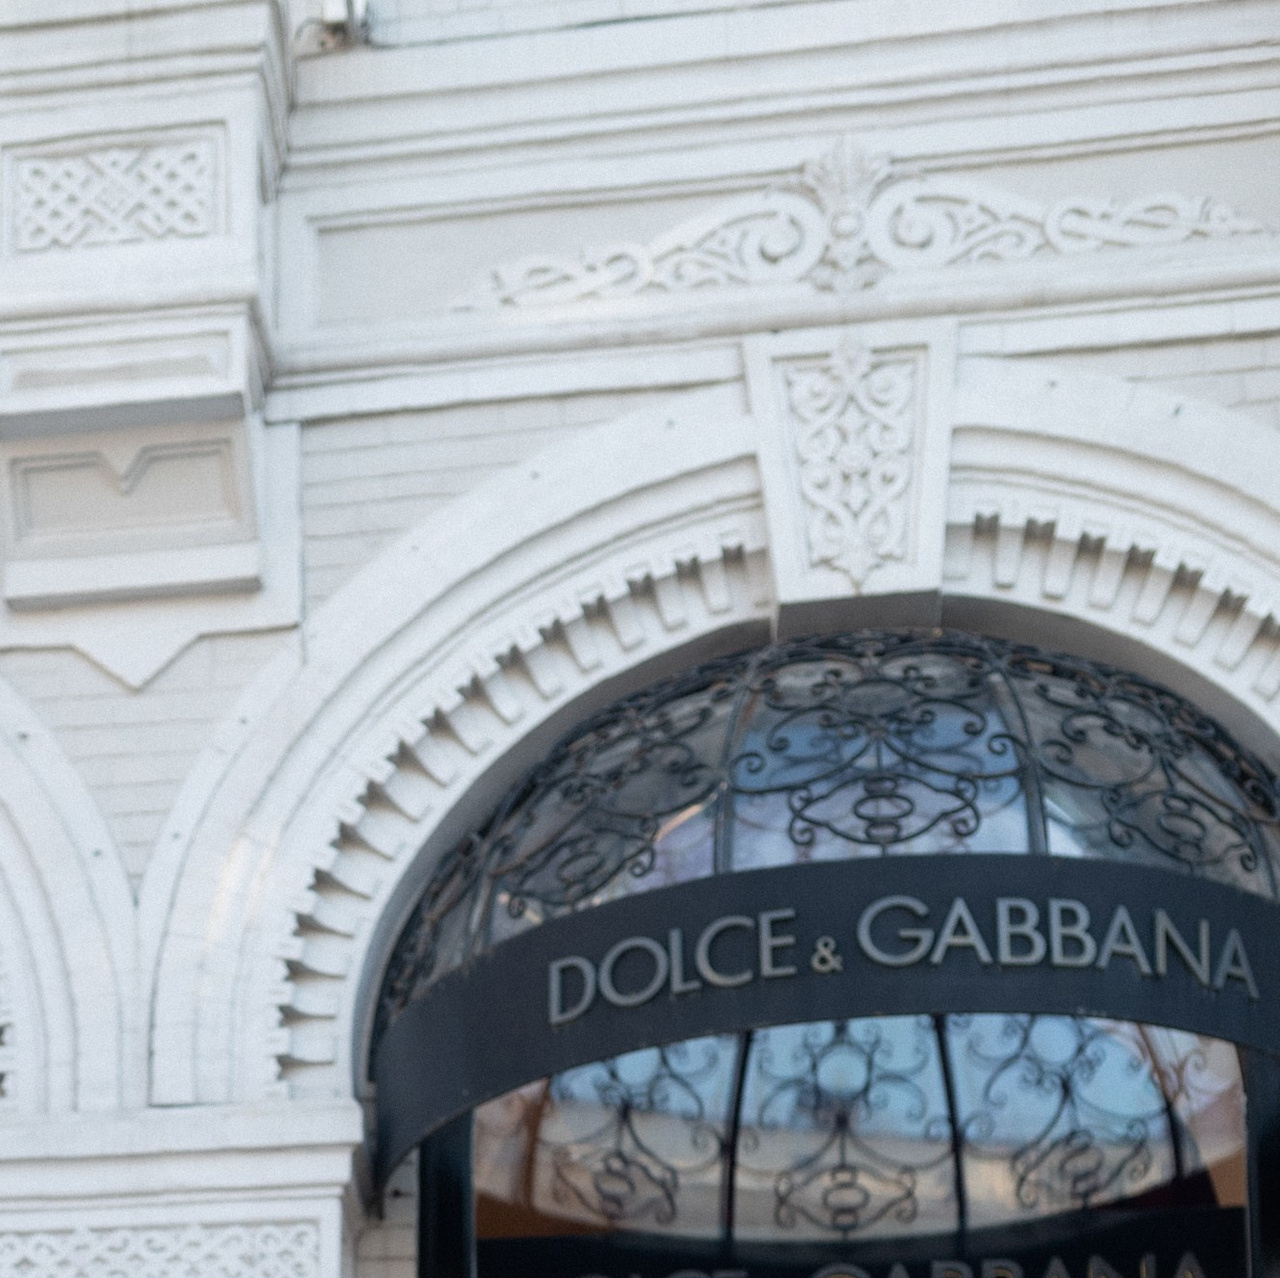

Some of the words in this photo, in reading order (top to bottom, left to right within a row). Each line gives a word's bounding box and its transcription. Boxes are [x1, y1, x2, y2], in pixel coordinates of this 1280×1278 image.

[548, 906, 798, 1026] DOLCE
[810, 935, 844, 974] &
[857, 894, 1260, 1000] GABBANA
